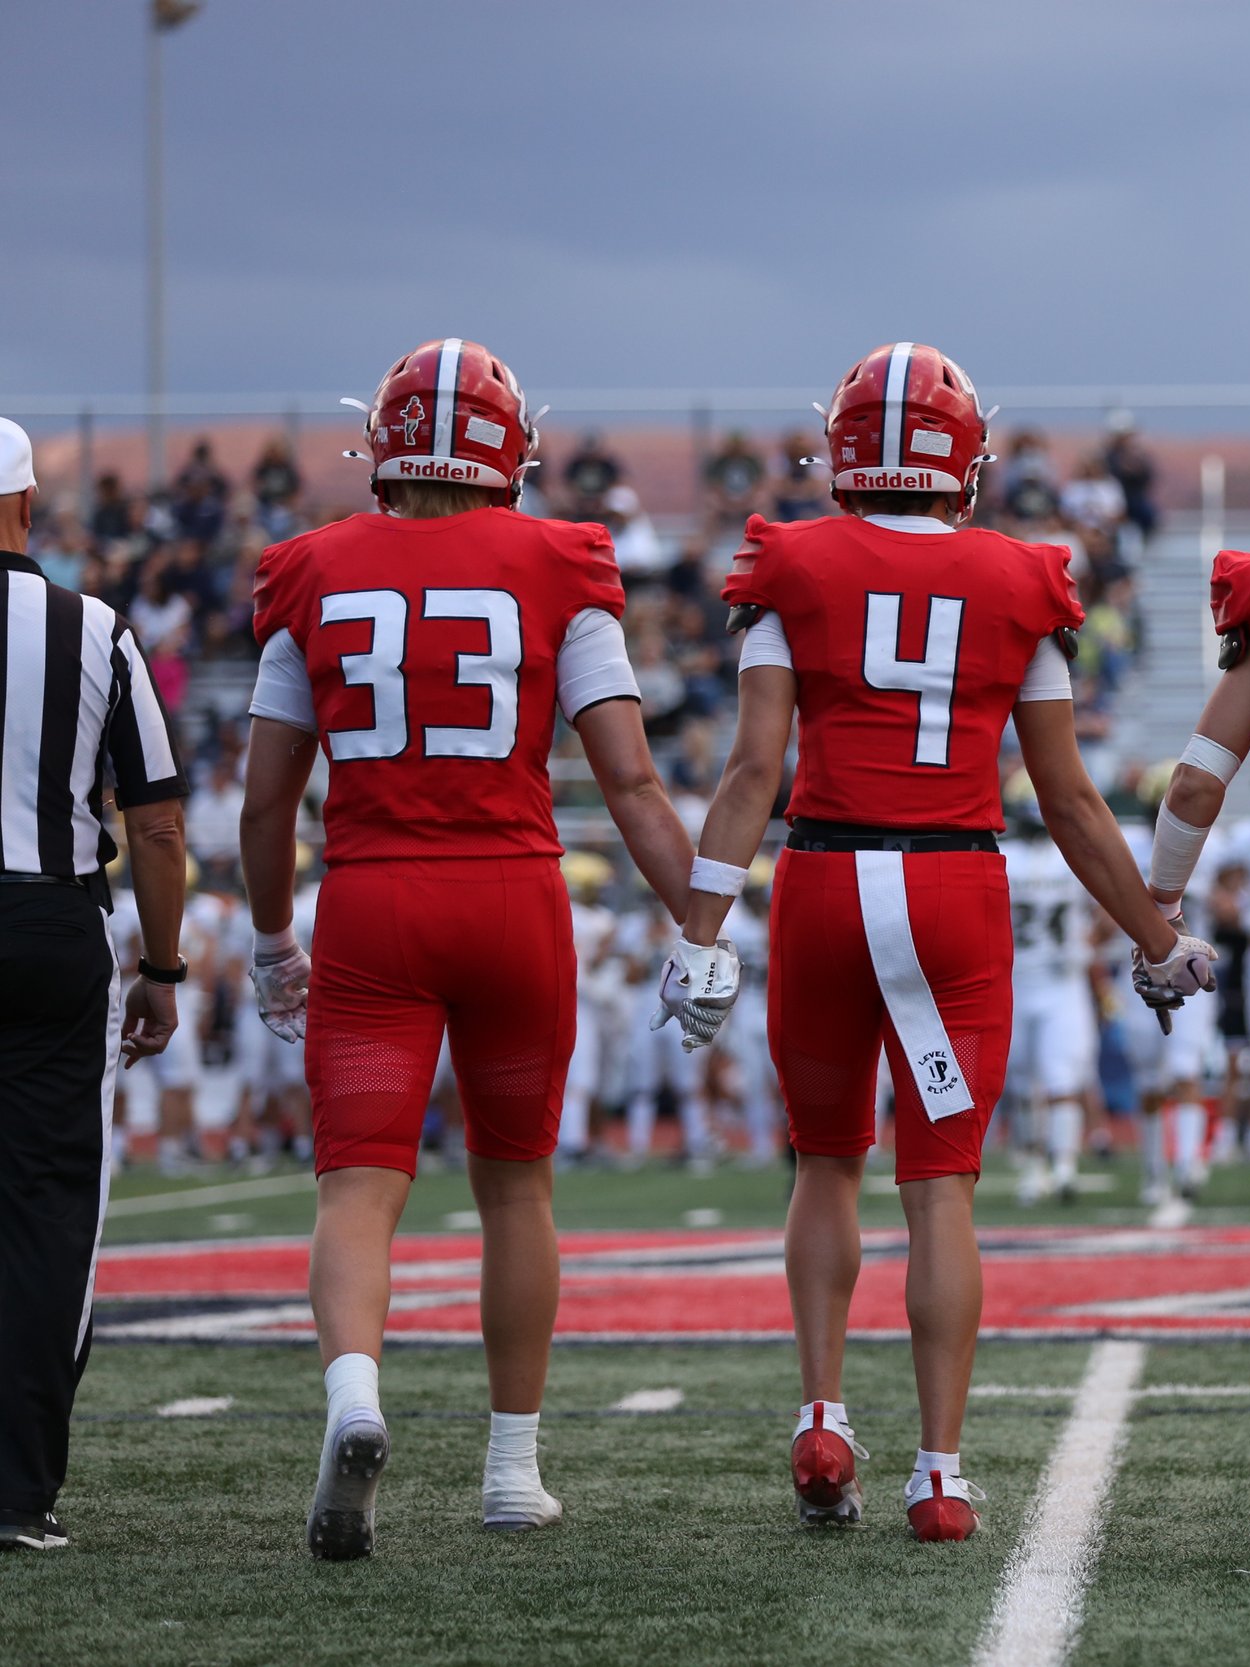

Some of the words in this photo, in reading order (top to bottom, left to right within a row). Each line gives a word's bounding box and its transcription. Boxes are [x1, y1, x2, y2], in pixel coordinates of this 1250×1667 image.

[400, 460, 479, 480] Riddell
[853, 472, 932, 489] Riddell
[319, 587, 524, 762] 33
[860, 590, 967, 768] 4
[918, 1051, 947, 1066] LEVEL
[927, 1076, 958, 1095] ELITES
